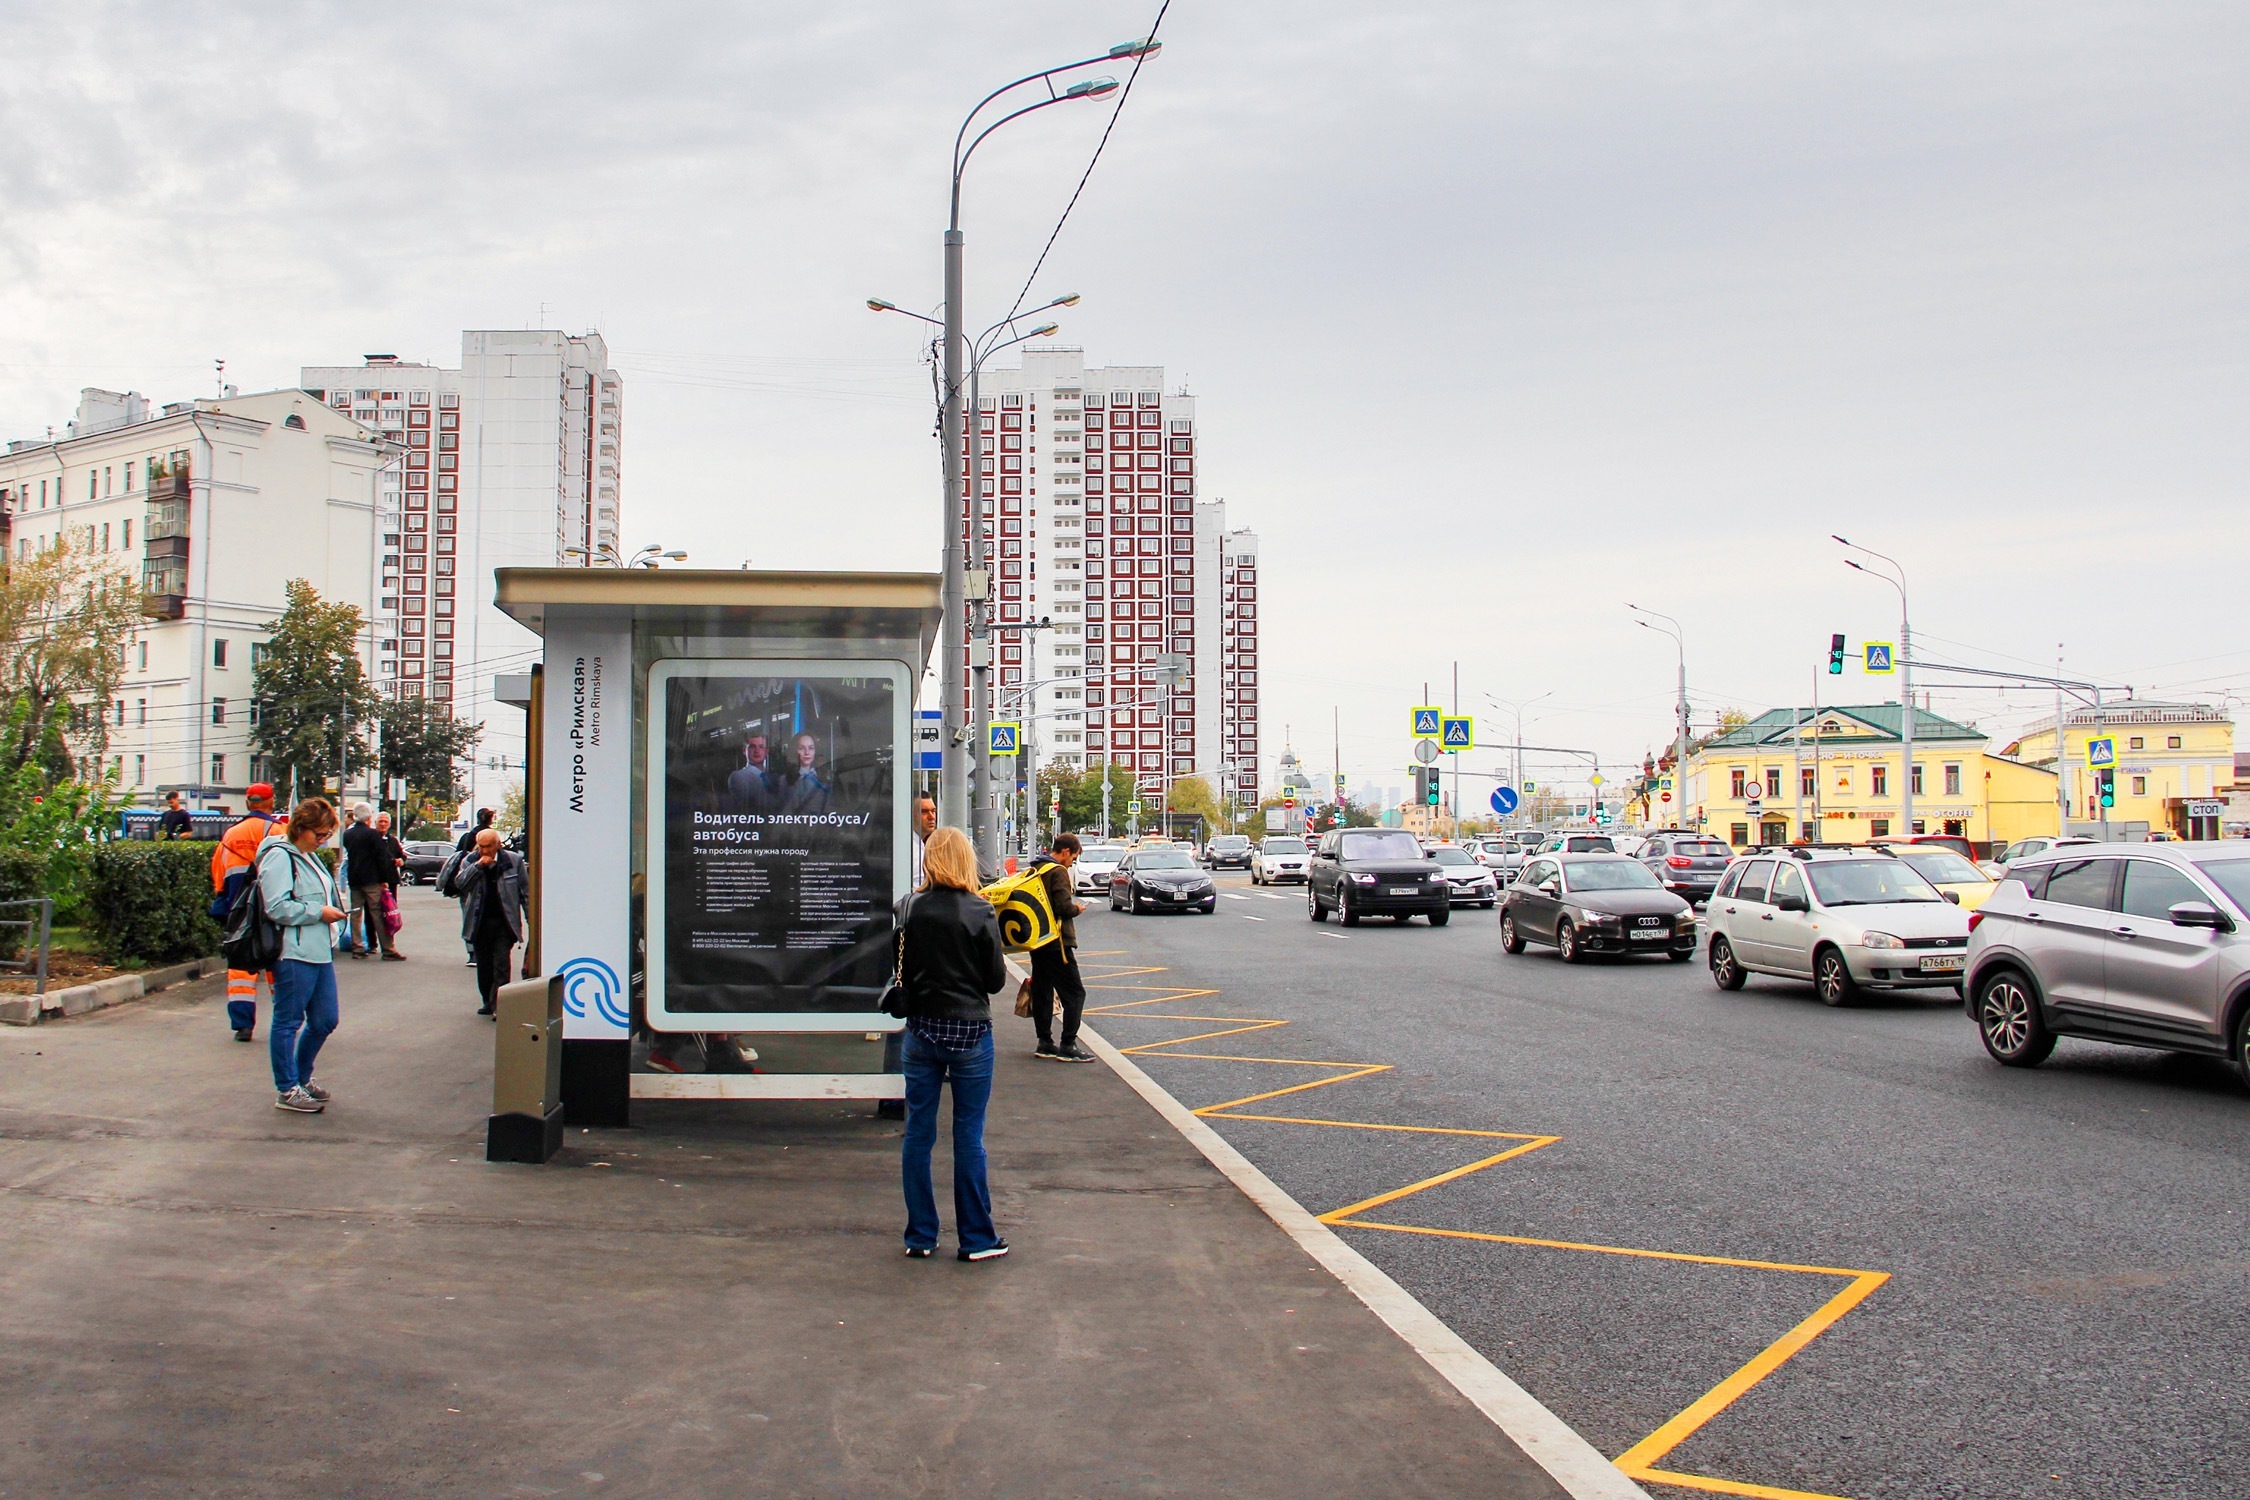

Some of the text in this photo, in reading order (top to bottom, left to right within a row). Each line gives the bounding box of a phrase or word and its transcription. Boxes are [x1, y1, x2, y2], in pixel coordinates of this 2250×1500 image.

[590, 656, 604, 746] Metro Rimskaya
[569, 657, 587, 813] Метро «Римская»
[2192, 805, 2219, 815] СТОП
[694, 811, 764, 826] Водитель
[693, 828, 760, 843] автобуса
[693, 846, 809, 857] Эта профессия нужна городу
